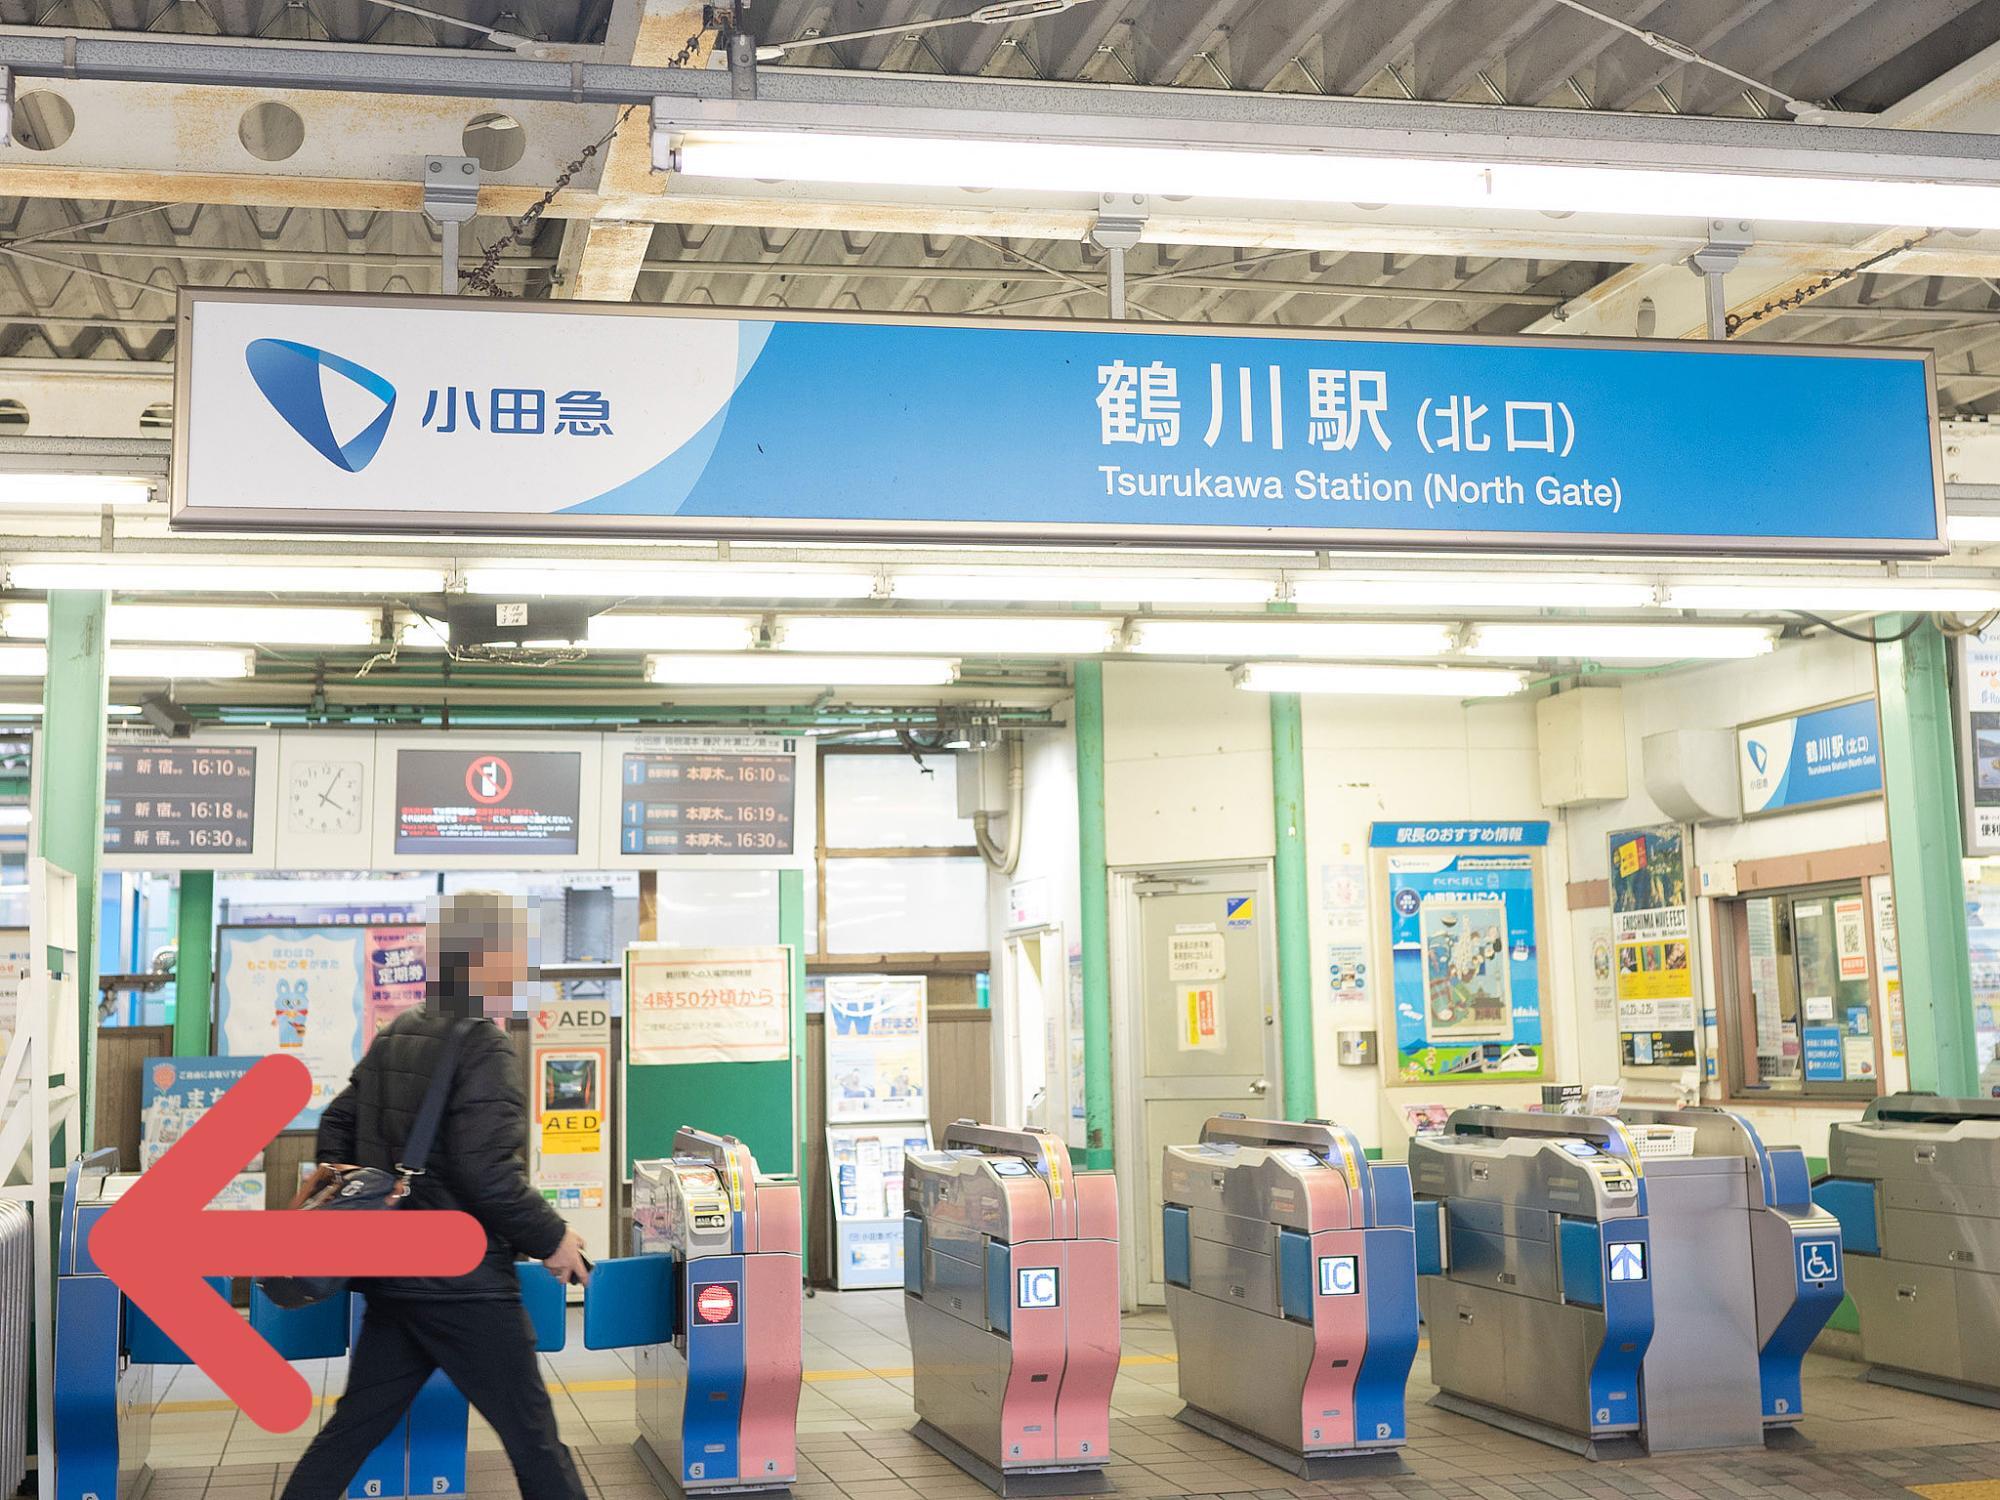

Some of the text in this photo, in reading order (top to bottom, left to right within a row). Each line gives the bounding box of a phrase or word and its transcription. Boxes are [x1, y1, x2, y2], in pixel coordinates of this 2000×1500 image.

[422, 386, 614, 436] 小田急
[1095, 359, 1575, 457] 鶴川駅 (北口)
[1098, 465, 1622, 513] Tsurukawa Station (North Gate)
[191, 758, 234, 777] 16:10
[629, 763, 639, 783] 1
[738, 767, 776, 782] 16:10
[190, 801, 233, 819] 16:18
[628, 805, 637, 823] 1
[737, 807, 776, 822] 16:19
[189, 829, 233, 847] 16:30
[628, 831, 637, 849] 1
[736, 833, 776, 848] 16:30
[1396, 827, 1524, 843] 駅長のおすすめ情報
[642, 988, 774, 1010] 4時50分頃から
[558, 1010, 606, 1028] AED
[546, 1115, 598, 1131] AED
[1323, 1262, 1353, 1291] IC
[1023, 1273, 1053, 1303] IC
[370, 1483, 377, 1493] 6
[436, 1480, 443, 1490] 5
